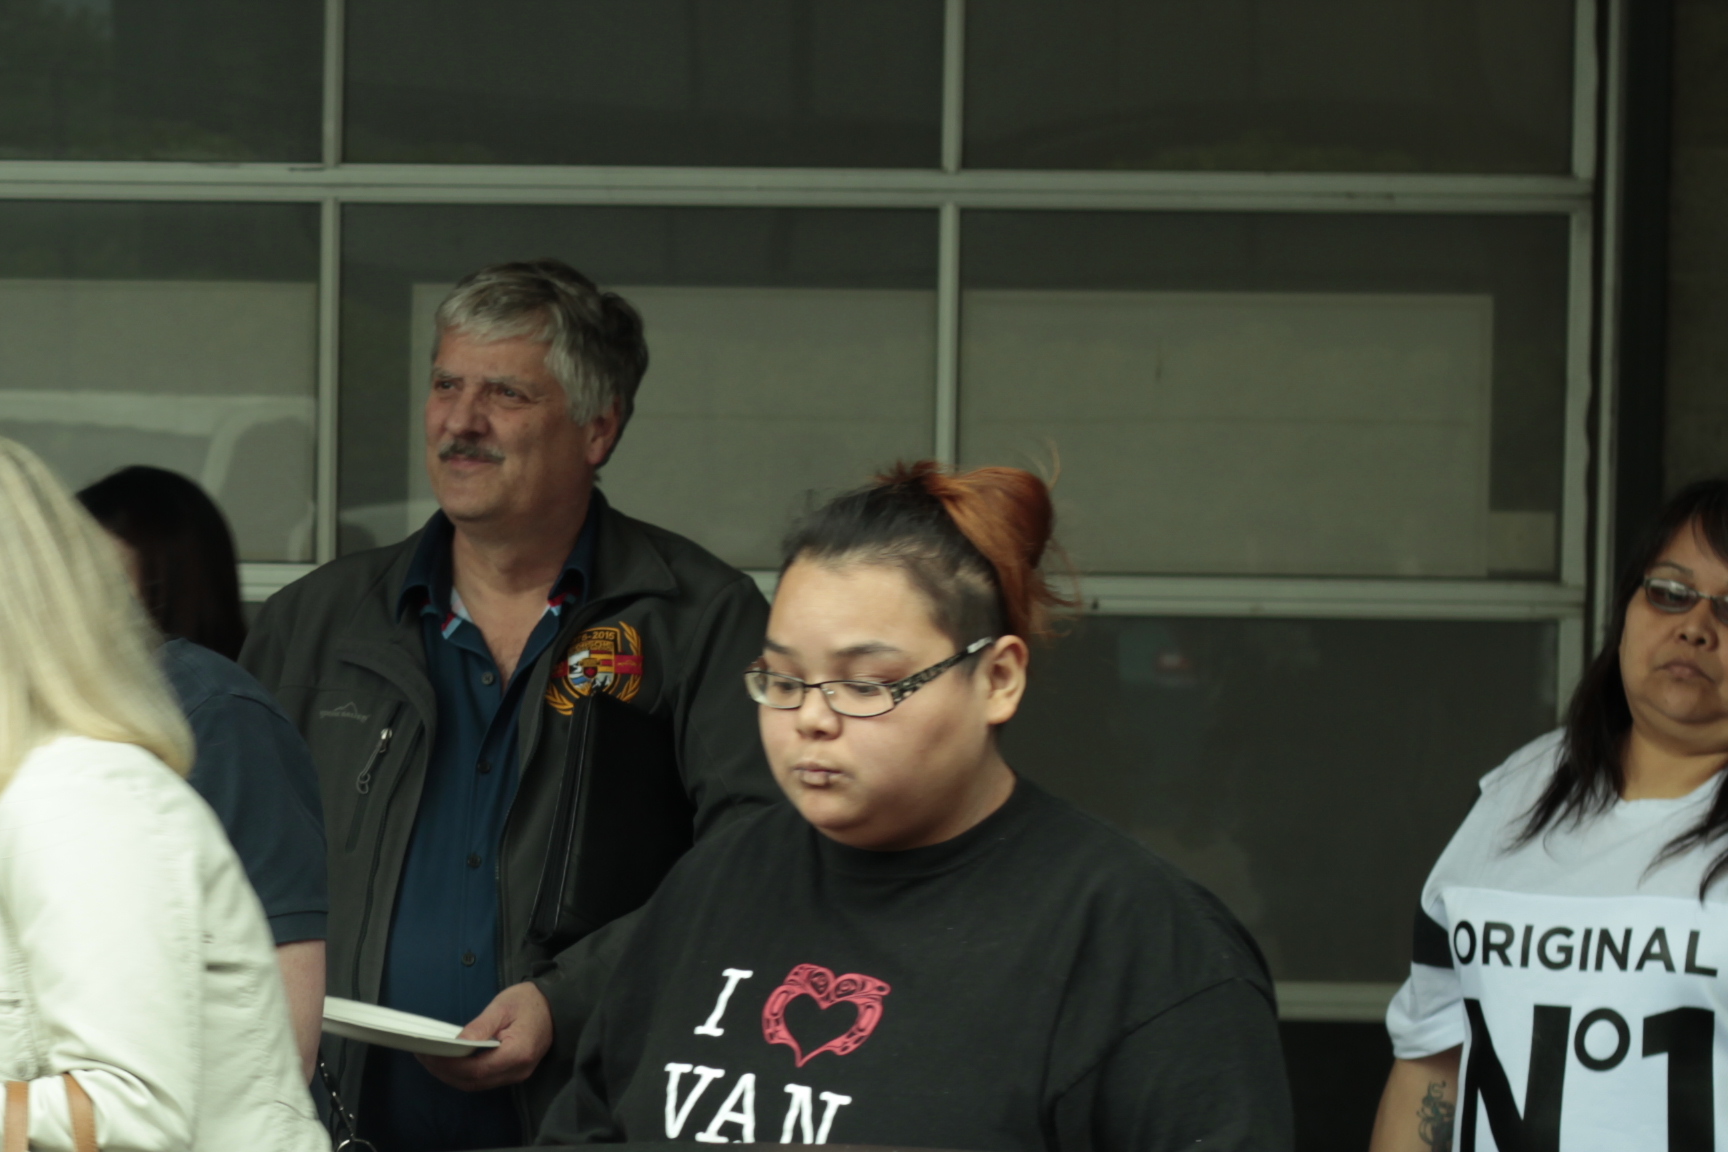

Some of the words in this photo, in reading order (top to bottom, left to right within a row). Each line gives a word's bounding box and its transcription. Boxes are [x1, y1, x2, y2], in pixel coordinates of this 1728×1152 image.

[1452, 919, 1719, 978] ORIGINAL
[694, 967, 754, 1037] I
[664, 1062, 852, 1145] VAN
